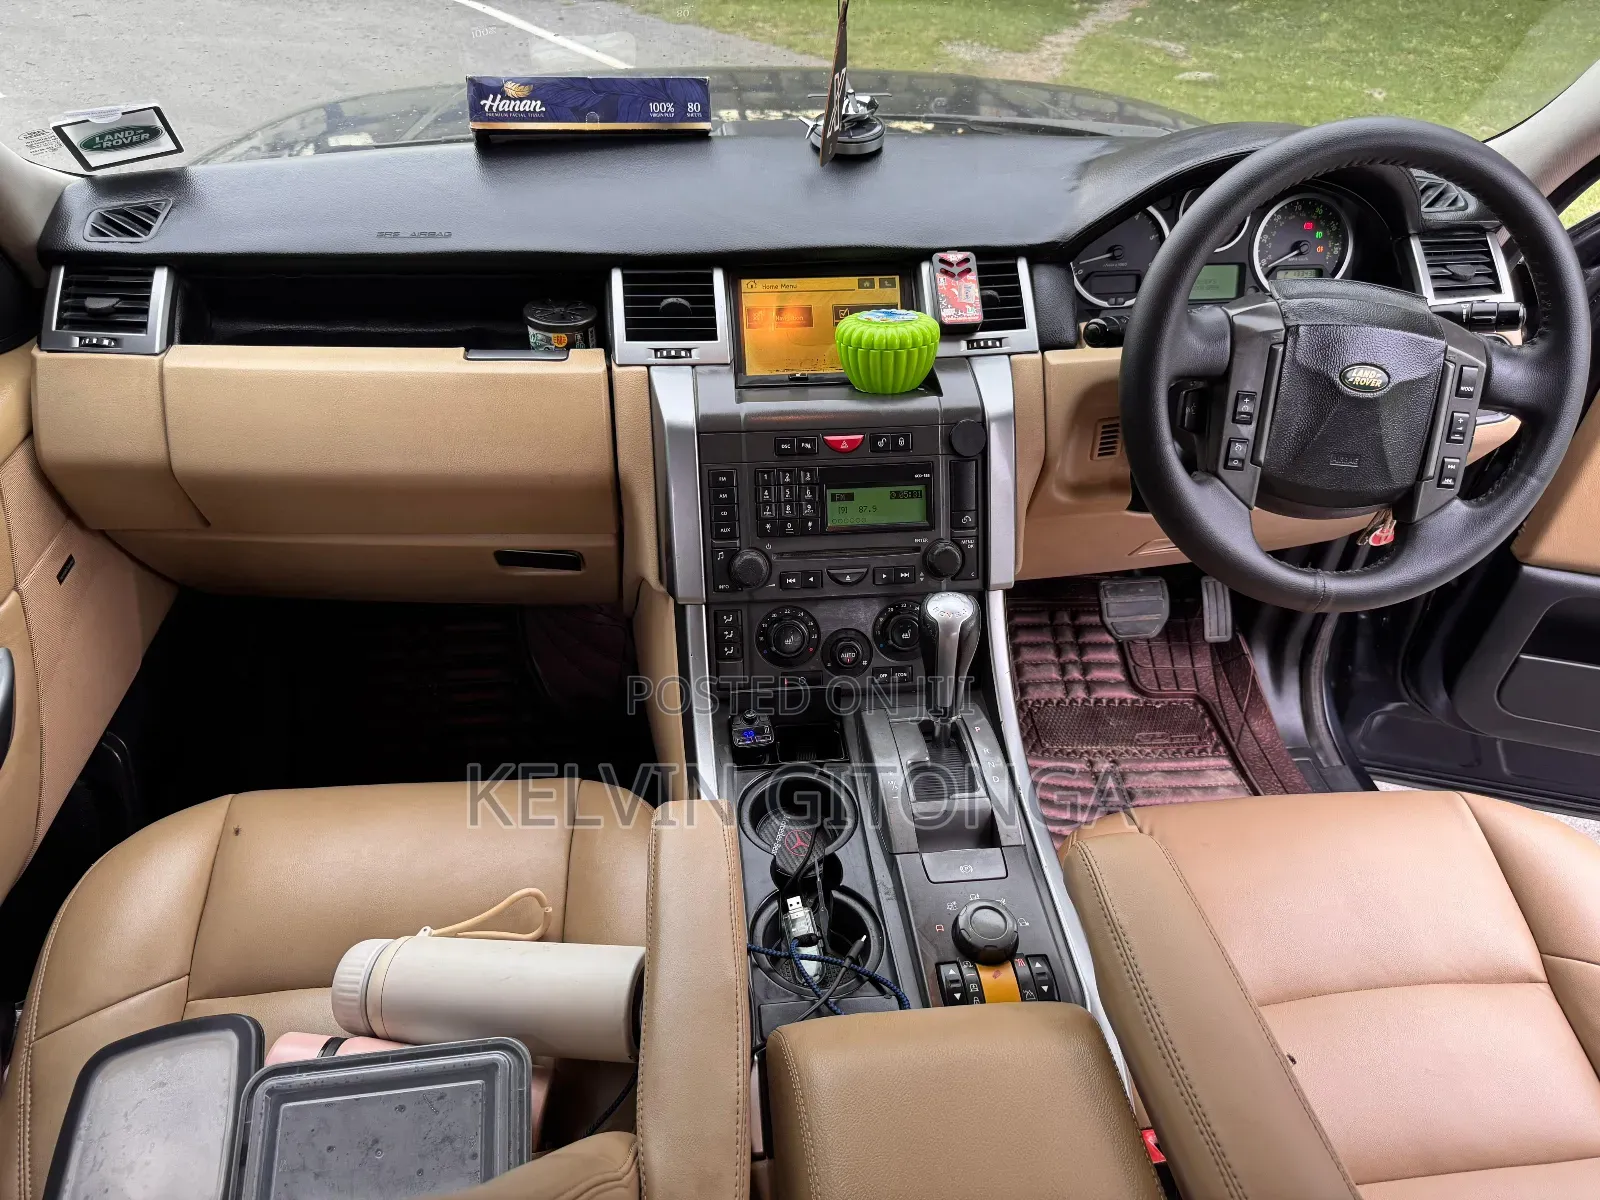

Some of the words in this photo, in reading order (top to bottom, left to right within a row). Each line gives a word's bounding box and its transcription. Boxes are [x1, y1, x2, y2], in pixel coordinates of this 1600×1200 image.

[480, 94, 546, 112] Hanan
[649, 102, 675, 113] 100%
[687, 102, 701, 113] 80
[95, 130, 135, 143] LAND
[101, 133, 150, 149] ROVER
[1352, 368, 1377, 378] LAND
[1352, 377, 1382, 388] ROVER
[858, 505, 878, 513] 87.9
